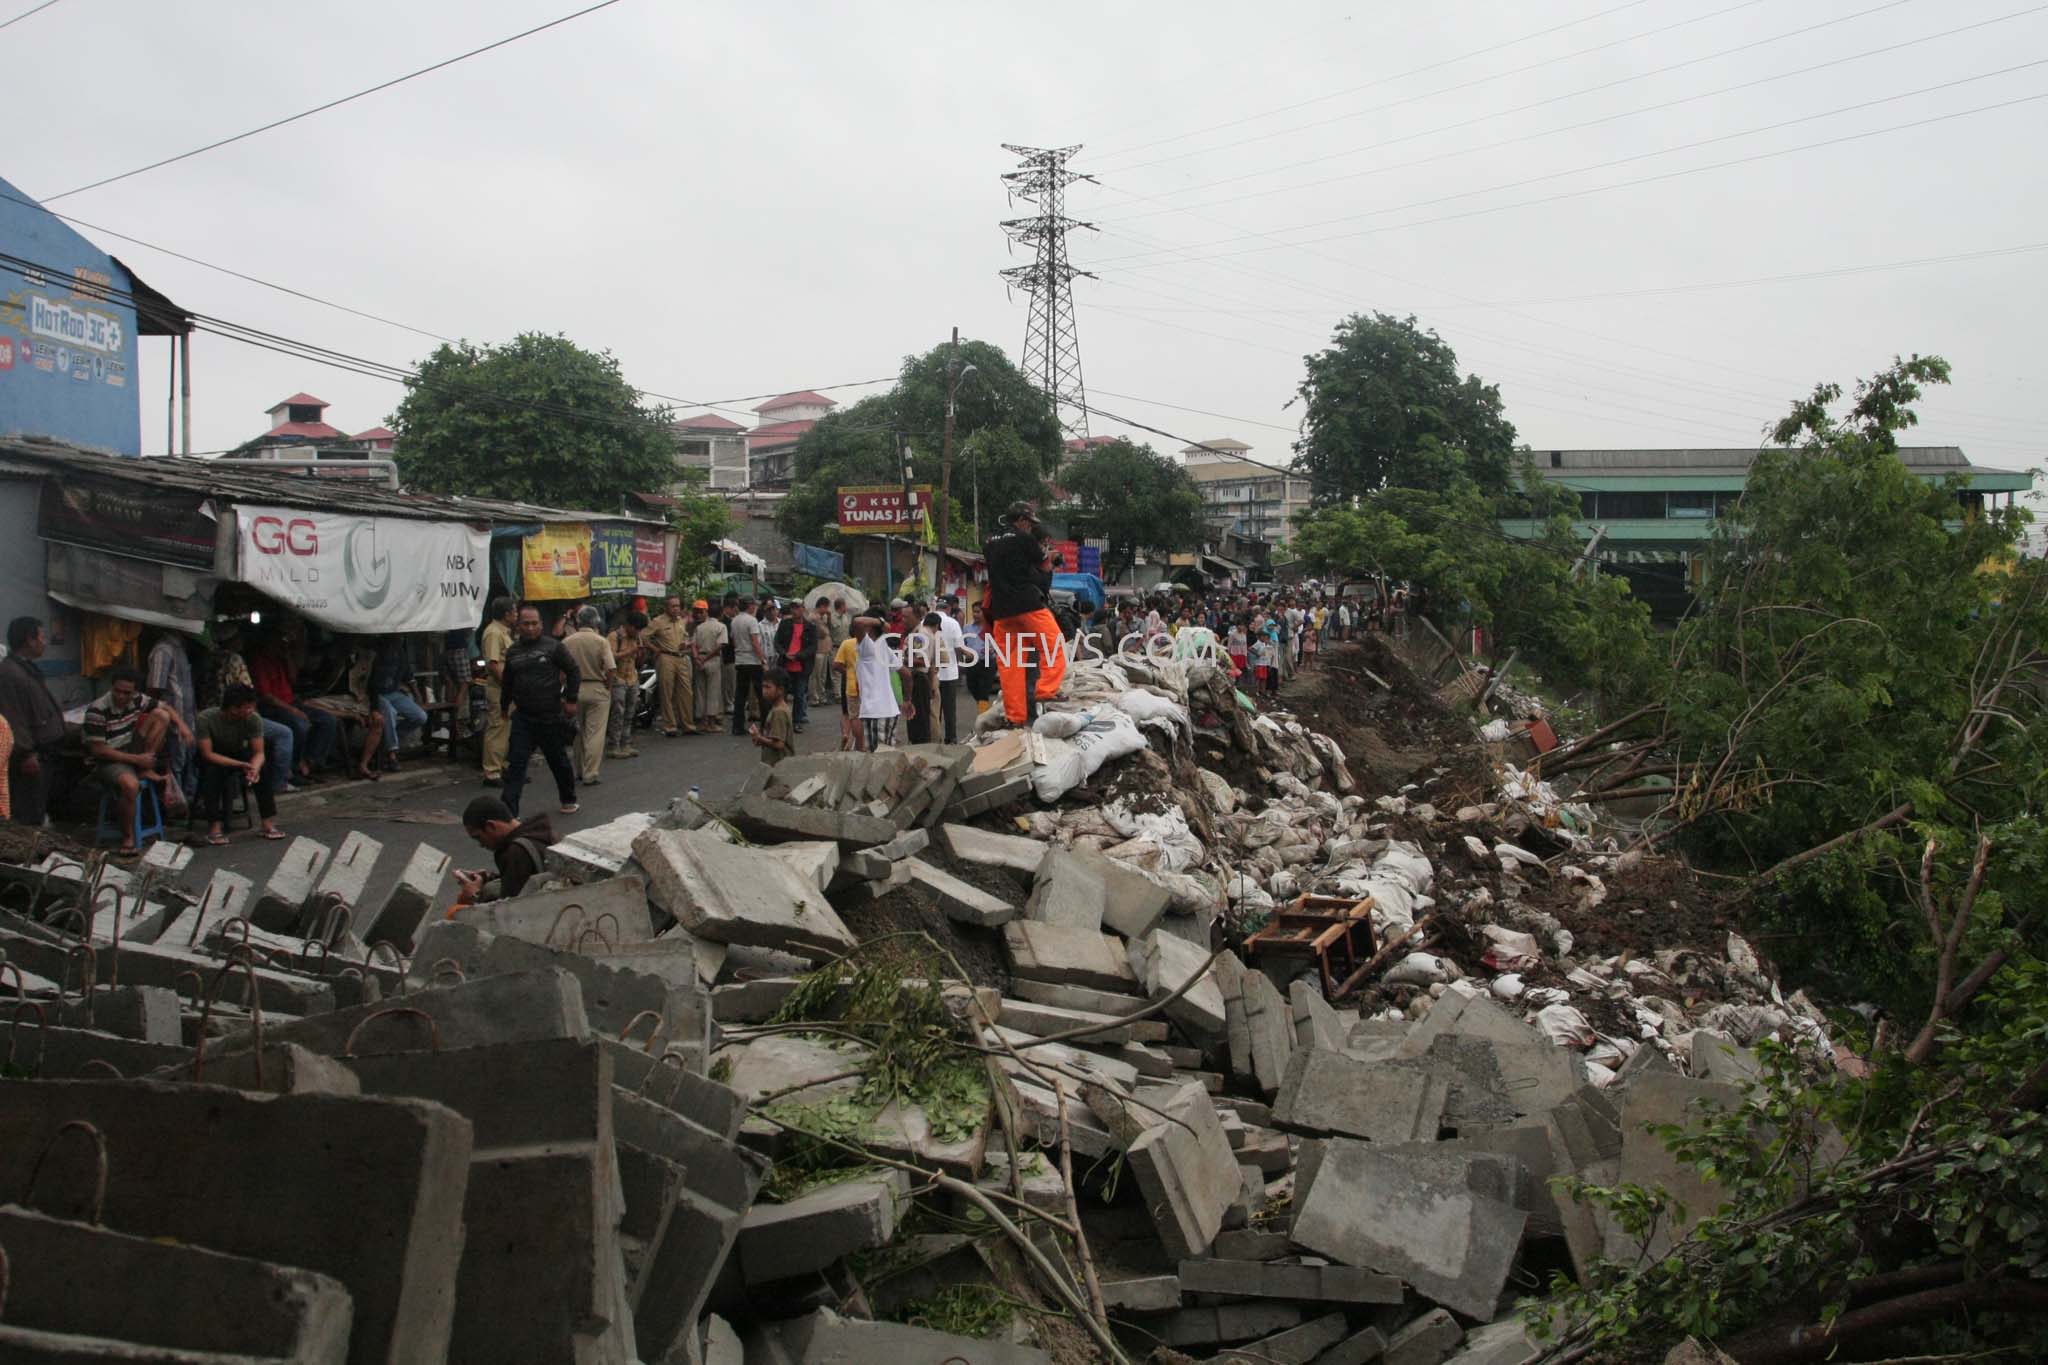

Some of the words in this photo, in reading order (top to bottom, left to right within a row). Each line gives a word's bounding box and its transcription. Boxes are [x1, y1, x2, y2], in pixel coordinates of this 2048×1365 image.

[870, 498, 900, 507] KSU
[844, 509, 893, 522] TUNAS
[252, 516, 318, 556] GG
[261, 567, 320, 583] MILD
